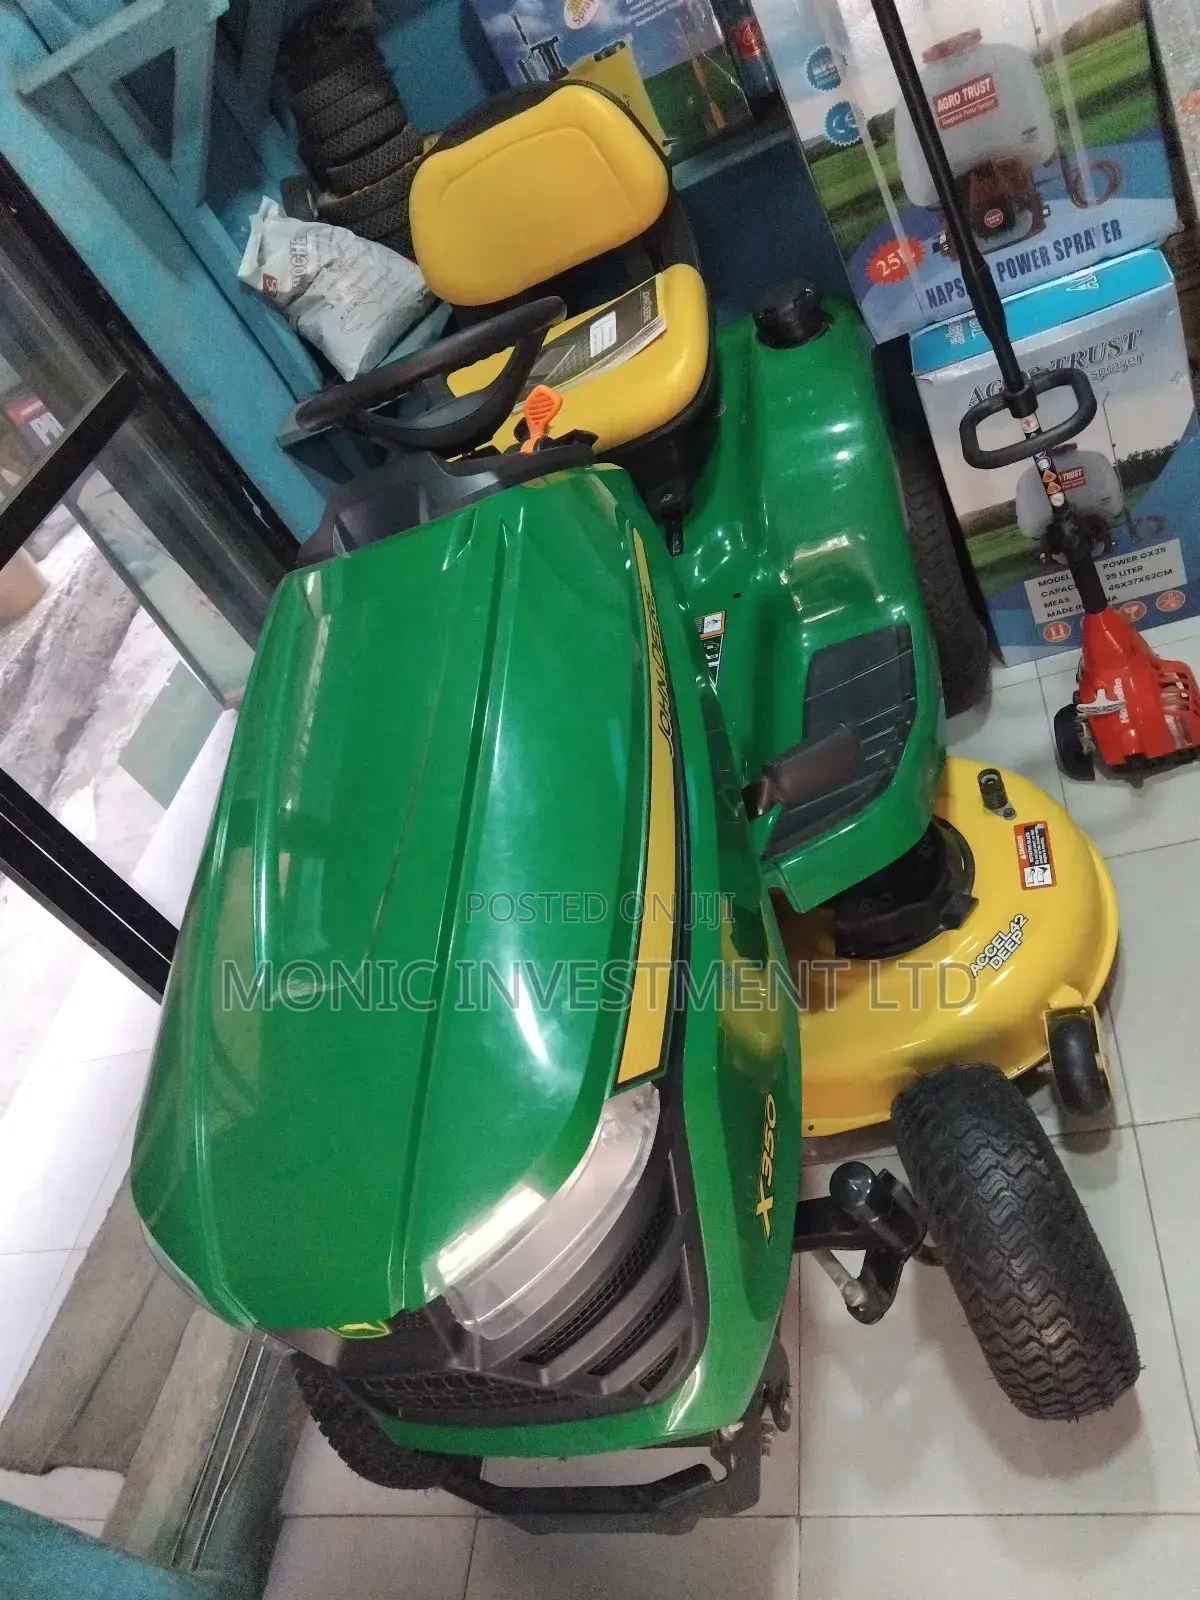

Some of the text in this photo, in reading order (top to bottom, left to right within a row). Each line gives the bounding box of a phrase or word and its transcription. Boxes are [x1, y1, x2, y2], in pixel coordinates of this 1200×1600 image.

[937, 77, 991, 113] AGRO TRUST
[995, 246, 1051, 283] POWER
[1062, 468, 1083, 481] TRUST
[1038, 546, 1167, 588] MODEL POWER GX35
[1105, 573, 1117, 581] 25
[1119, 565, 1143, 577] LITER
[1044, 596, 1070, 609] MEAS
[1047, 606, 1074, 618] MADE
[644, 584, 674, 757] JOHN DEERE
[969, 913, 1029, 979] ACCEL 42
[988, 931, 1024, 971] DEEP
[755, 1091, 777, 1245] X350
